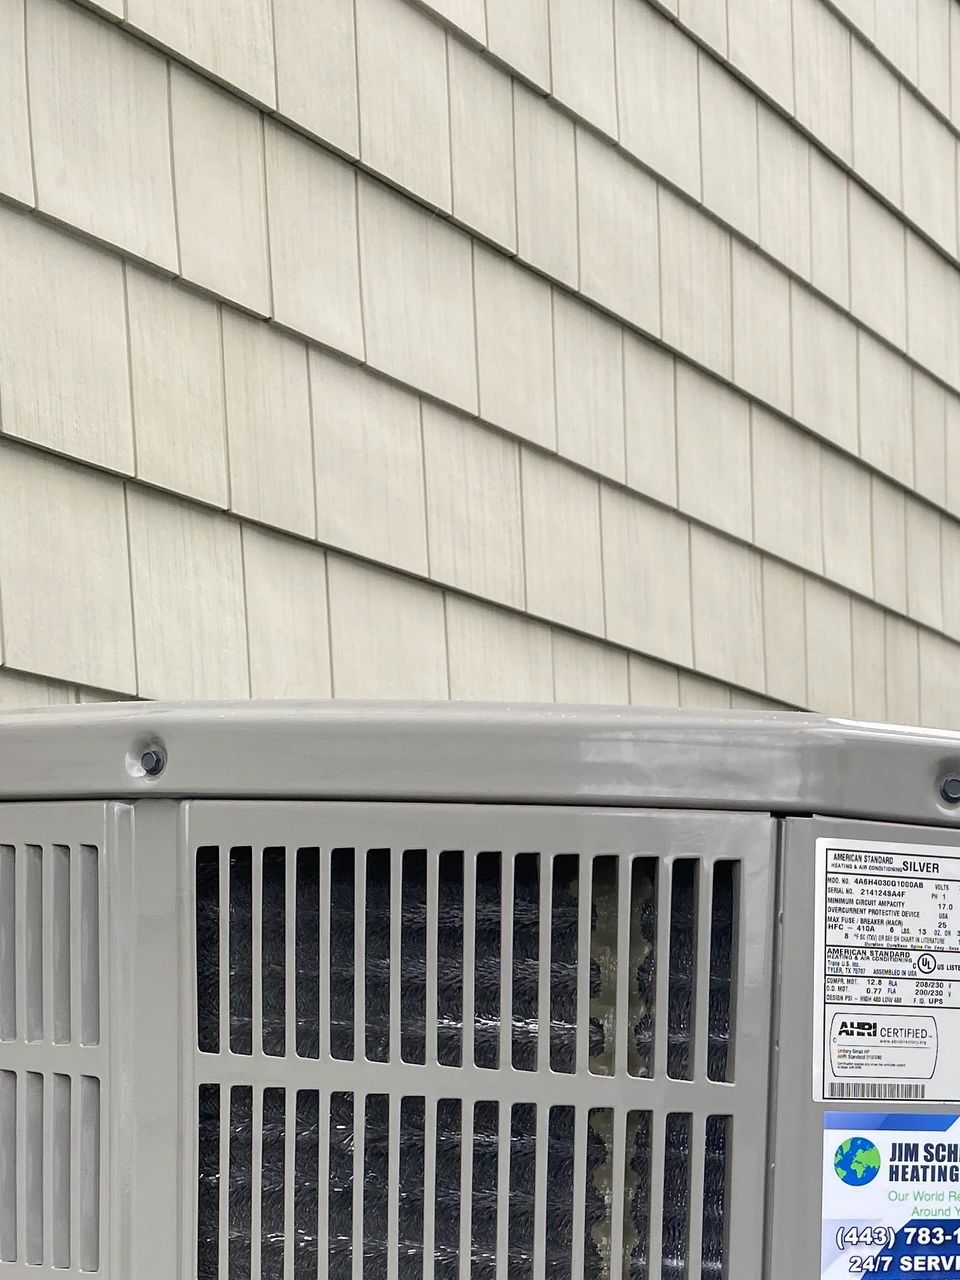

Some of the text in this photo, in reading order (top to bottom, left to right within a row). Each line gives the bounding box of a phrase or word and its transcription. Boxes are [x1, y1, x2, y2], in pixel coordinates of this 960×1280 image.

[834, 853, 894, 865] AMERICAN STANDARD
[902, 861, 939, 873] SILVER
[827, 897, 854, 905] MINIMUM
[878, 900, 906, 908] AMPACITY
[827, 906, 920, 918] OVERCURRENT PROTECTIVE DEVICE
[841, 916, 855, 924] FUSE
[860, 917, 884, 925] BREAKER
[827, 948, 911, 958] AMERICAN STANDARD
[838, 1021, 928, 1039] AHRI CERTIFIED
[889, 1143, 919, 1163] JIM
[888, 1165, 959, 1182] HEATING
[888, 1191, 909, 1202] Our
[912, 1191, 945, 1202] World
[911, 1206, 951, 1217] Around
[836, 1226, 895, 1249] (443)
[848, 1255, 893, 1273] 24/7
